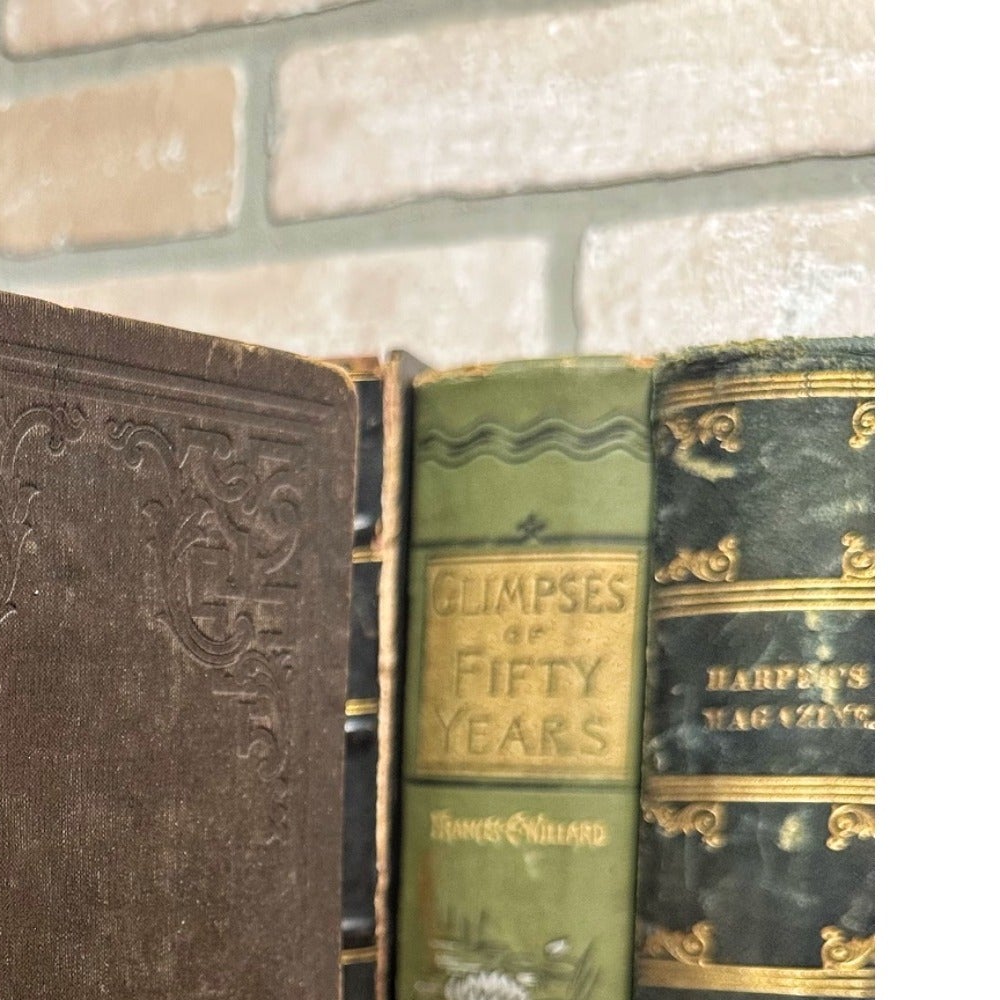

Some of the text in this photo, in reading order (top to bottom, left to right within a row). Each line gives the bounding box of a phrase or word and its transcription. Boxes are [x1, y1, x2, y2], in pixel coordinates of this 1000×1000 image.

[431, 569, 626, 618] GLIMPSES
[502, 623, 546, 645] OF
[455, 646, 608, 698] FIFTY
[433, 703, 607, 757] YEARS
